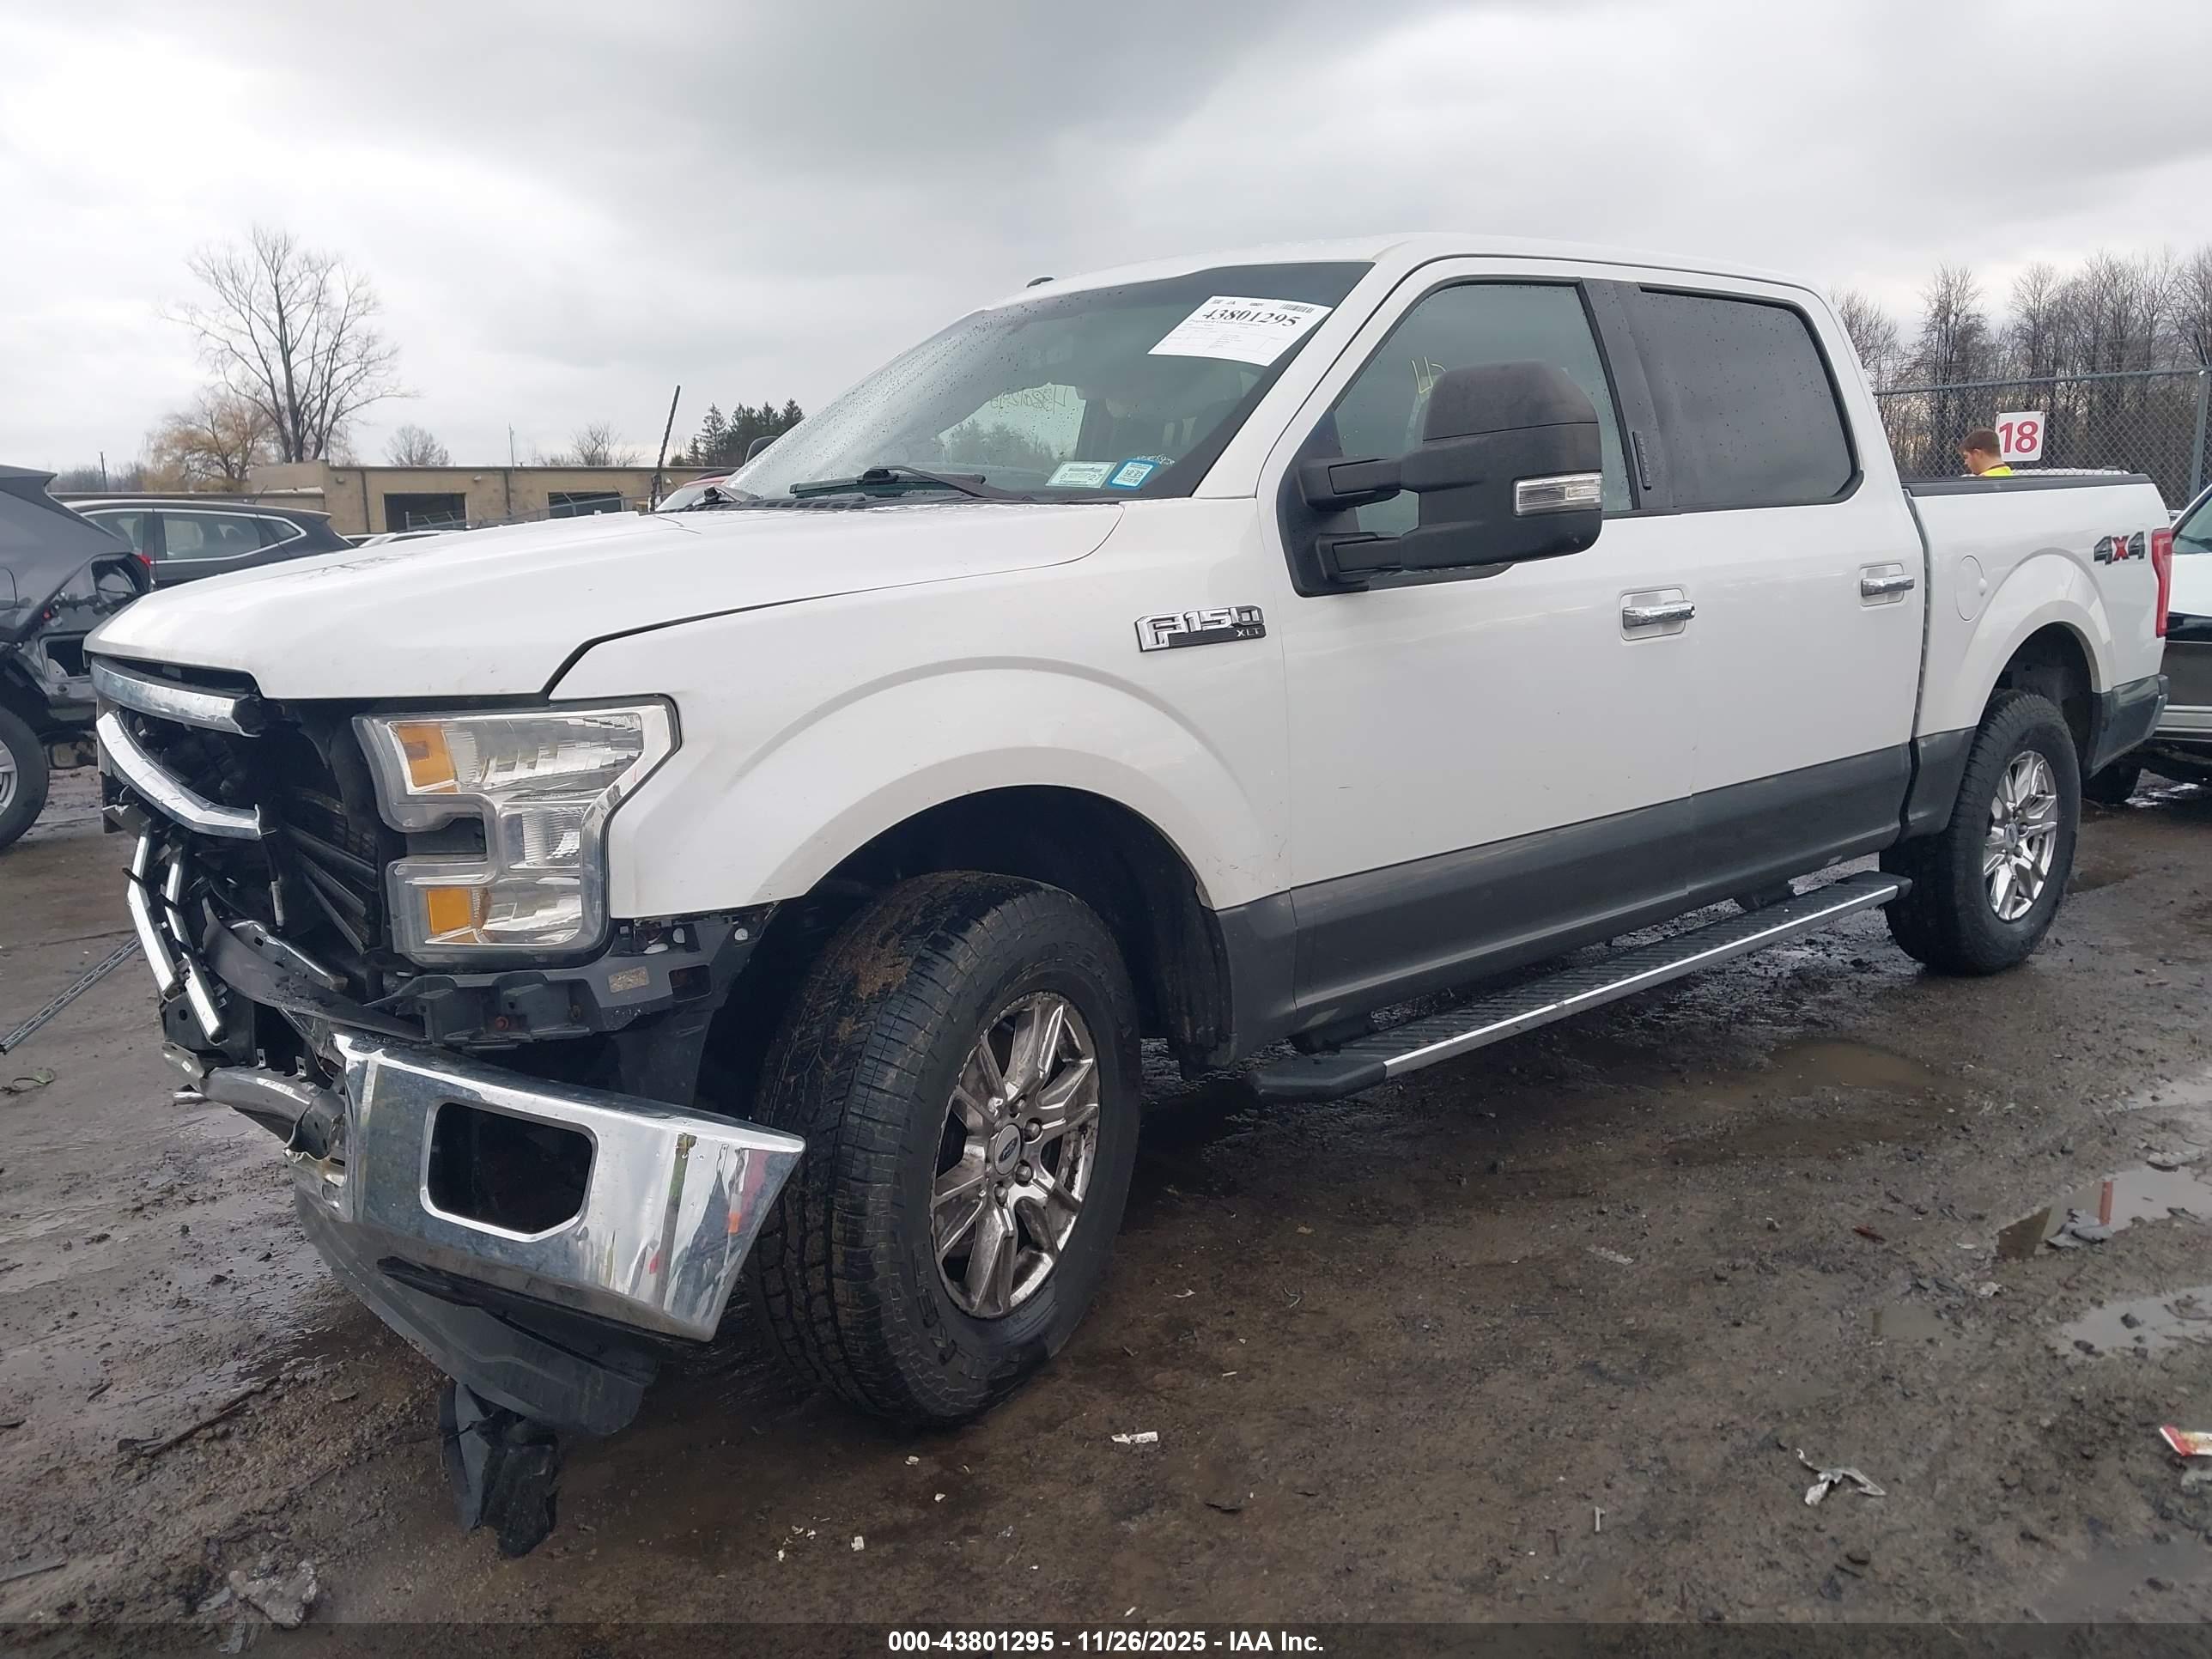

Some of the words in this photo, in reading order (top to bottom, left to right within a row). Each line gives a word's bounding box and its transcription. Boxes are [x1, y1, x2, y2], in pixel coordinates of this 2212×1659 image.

[1202, 308, 1302, 327] 43801295
[1998, 420, 2039, 453] 18
[1237, 628, 1260, 637] XLT
